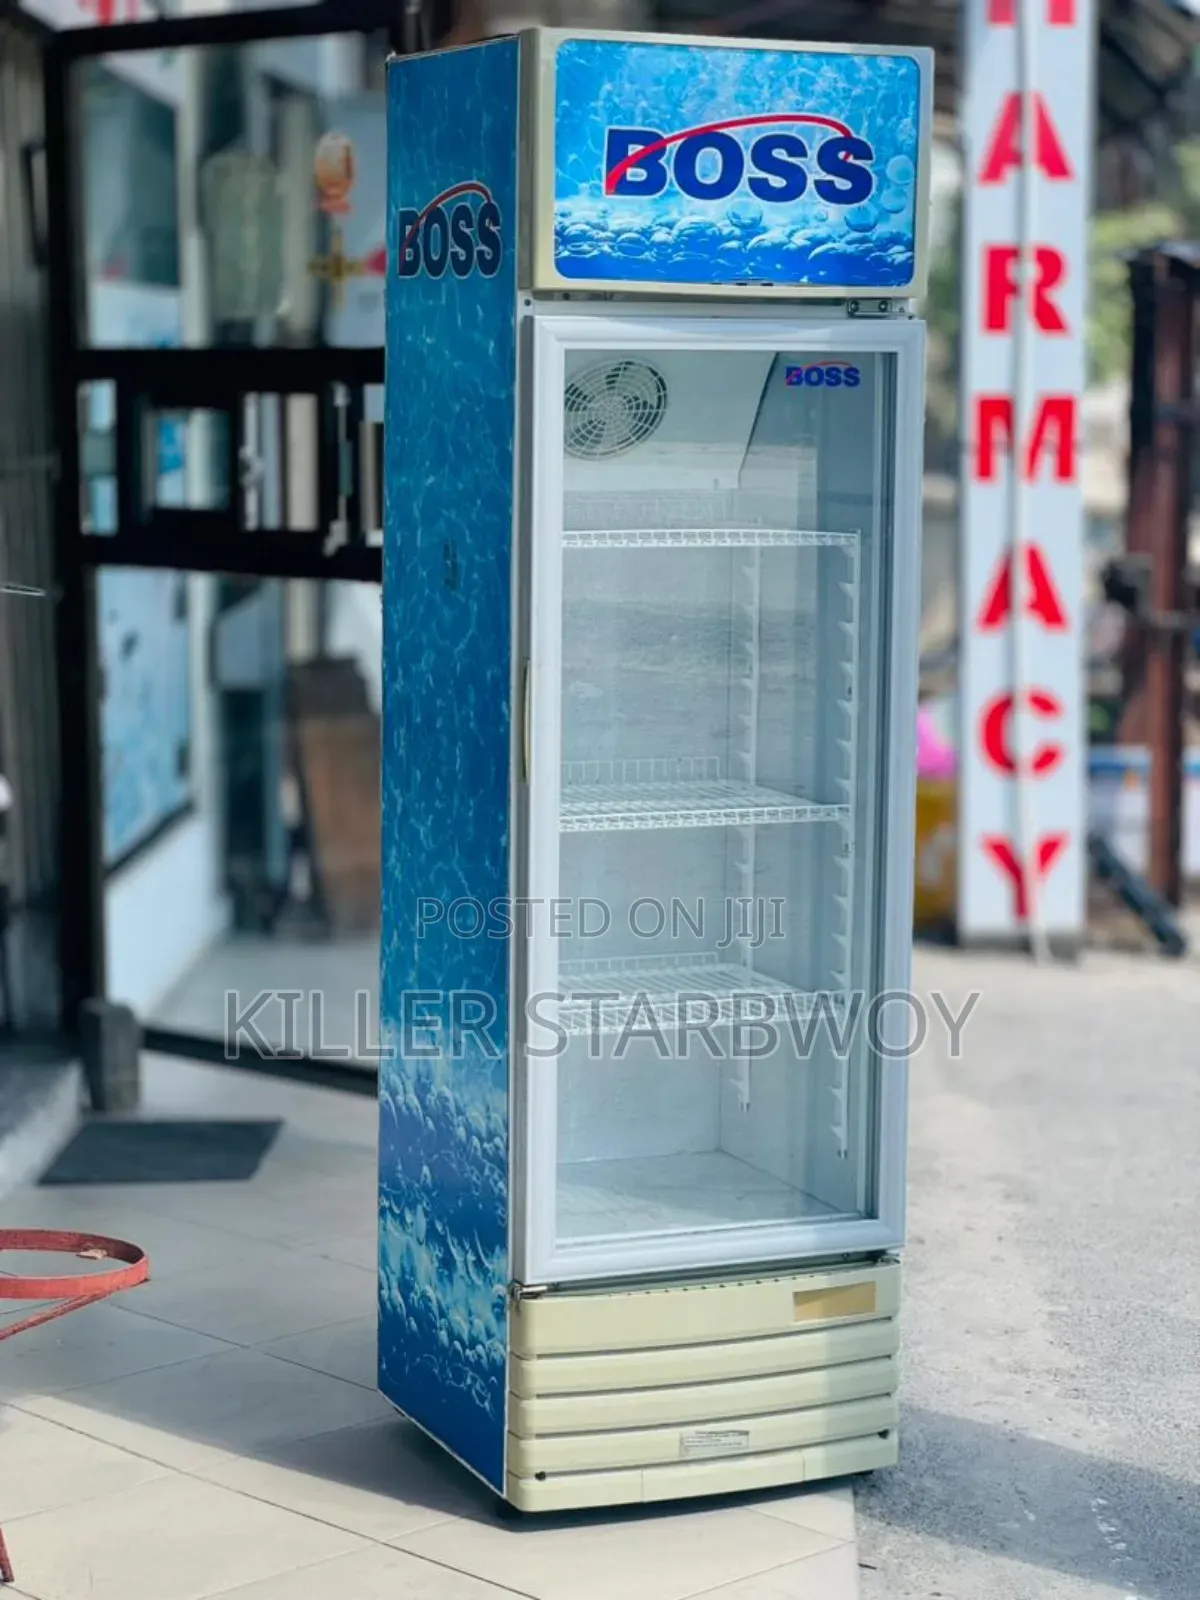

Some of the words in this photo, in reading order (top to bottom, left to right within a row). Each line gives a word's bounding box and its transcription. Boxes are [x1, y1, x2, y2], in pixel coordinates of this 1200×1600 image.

[604, 112, 876, 206] BOSS
[396, 179, 502, 279] BOSS
[784, 361, 862, 388] BOSS
